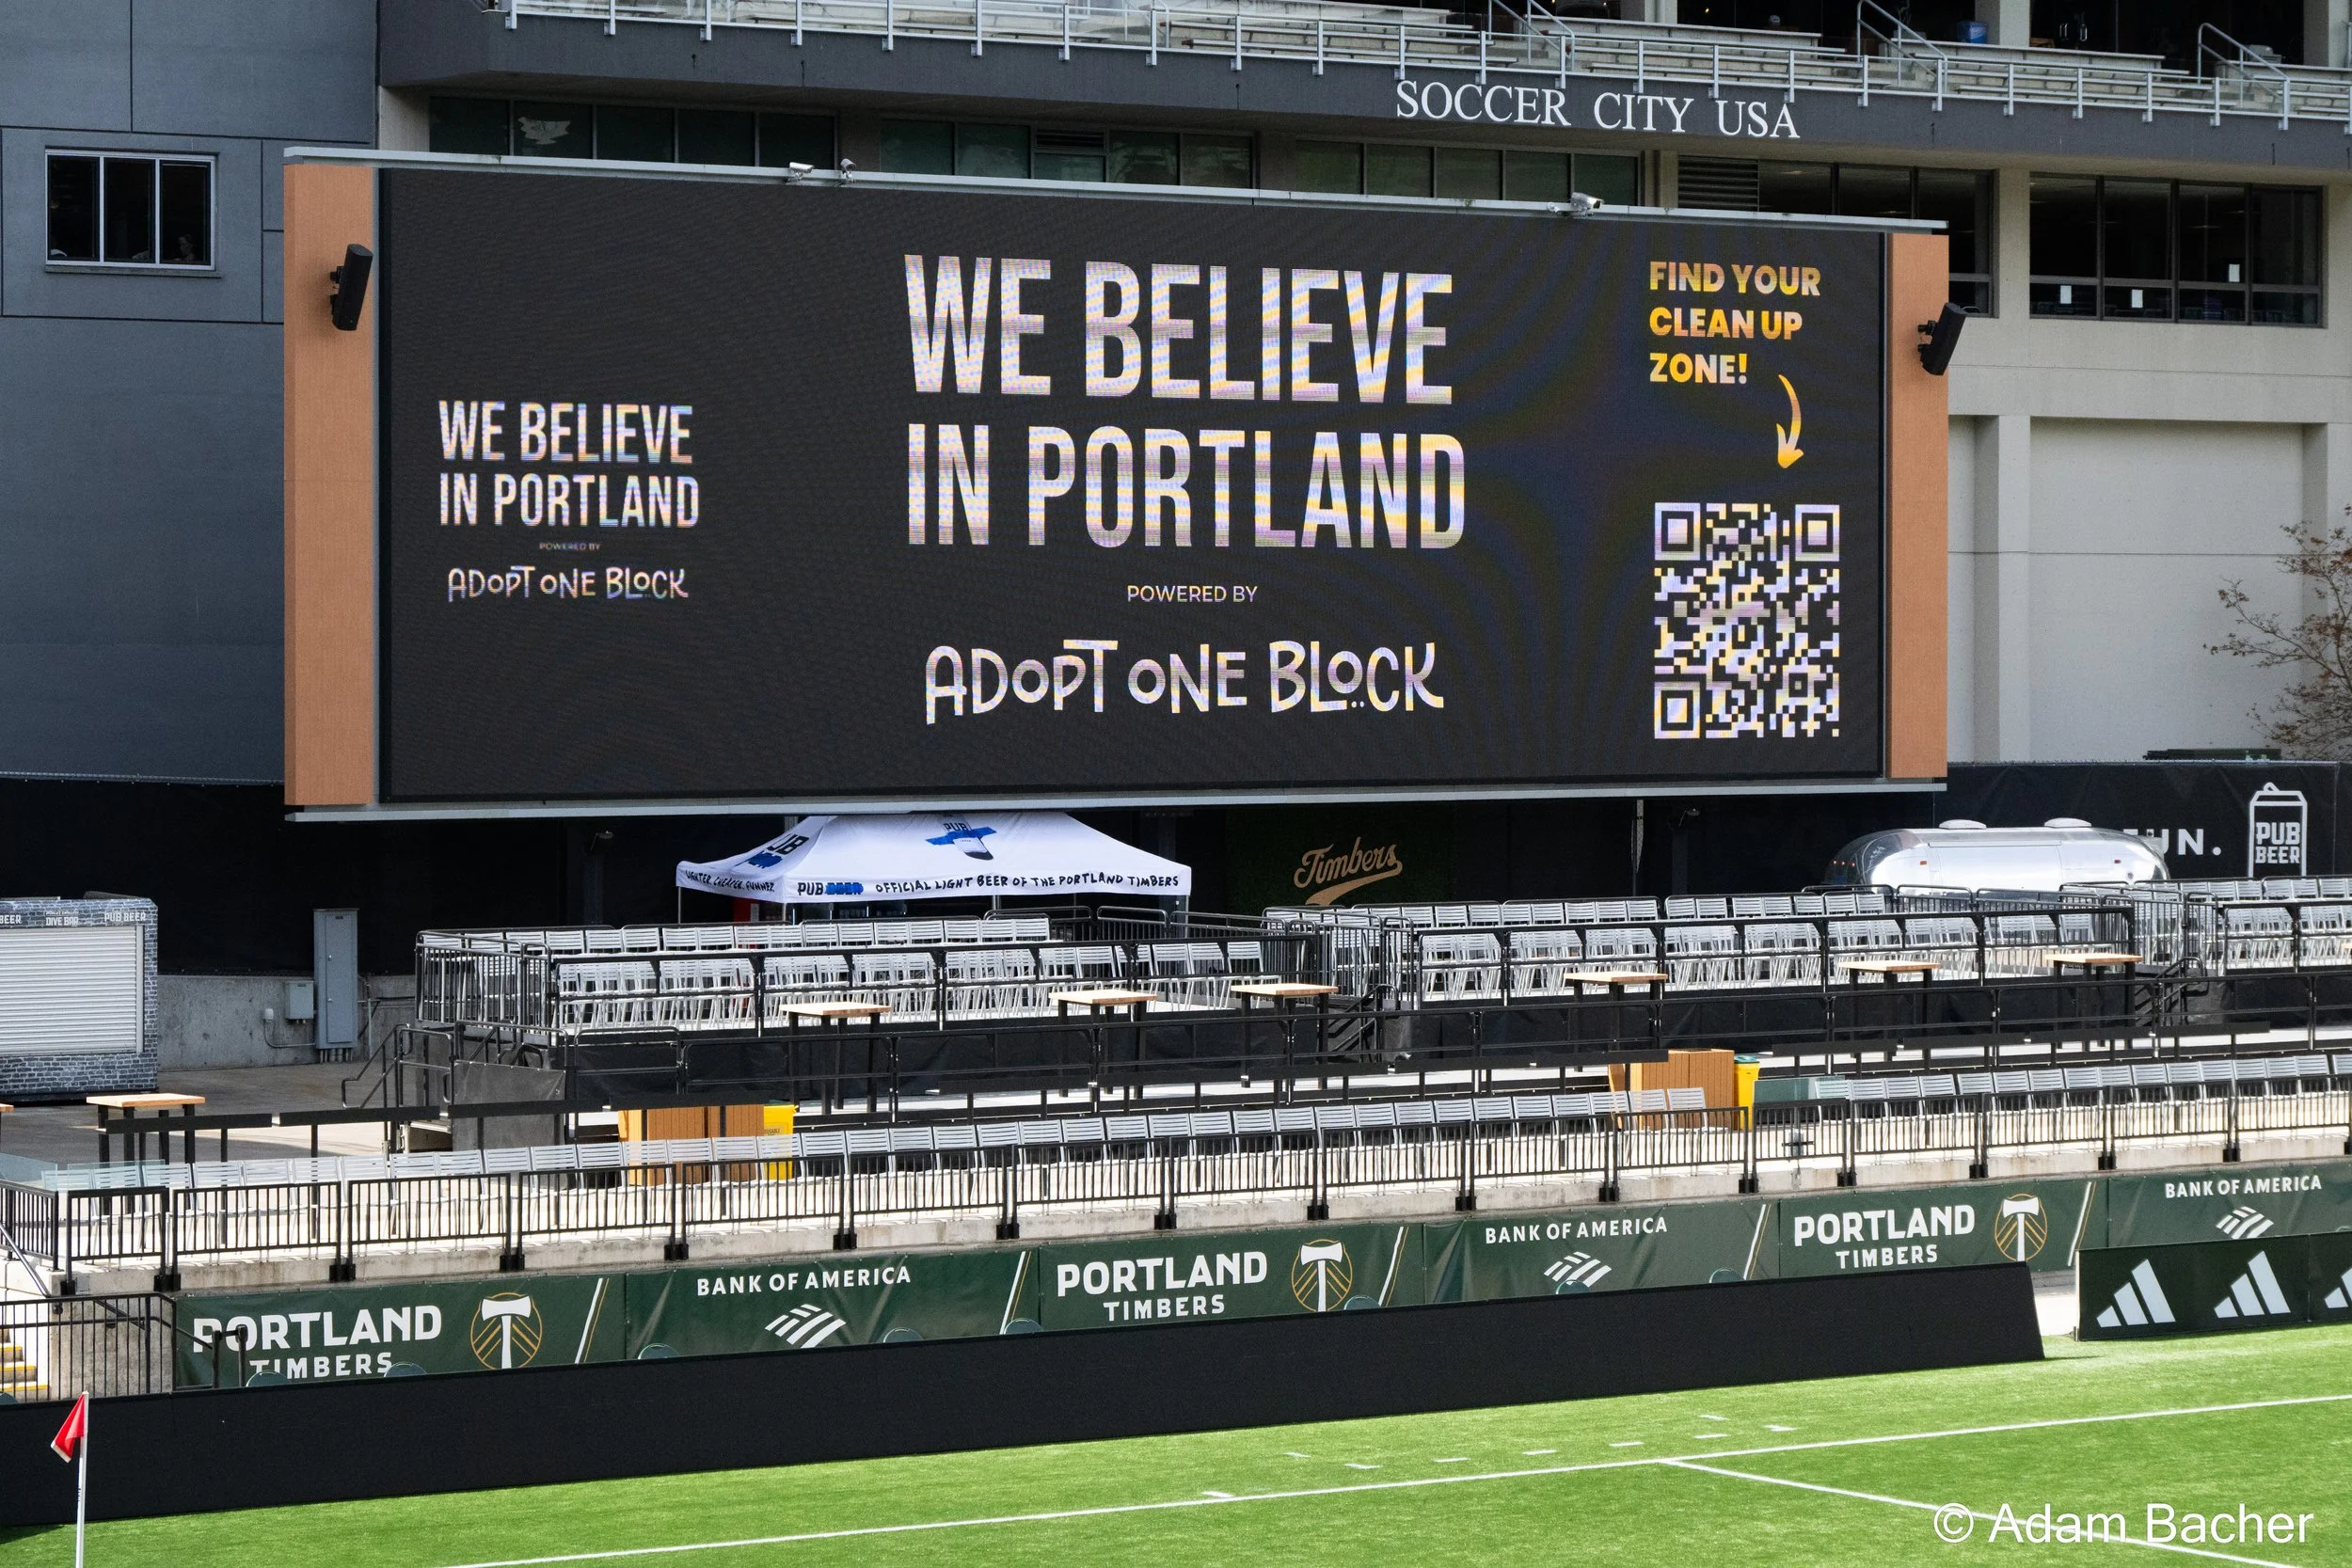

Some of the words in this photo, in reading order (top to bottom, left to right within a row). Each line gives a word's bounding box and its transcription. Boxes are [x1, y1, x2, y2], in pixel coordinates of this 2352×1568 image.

[1396, 80, 1571, 126] SOCCER
[1594, 92, 1694, 133] CITY
[1716, 100, 1801, 138] USA
[1649, 261, 1725, 293] FIND
[1731, 263, 1821, 296] YOUR
[904, 254, 1052, 396] WE
[1085, 261, 1453, 404] BELIEVE
[1649, 307, 1755, 340] CLEAN
[1761, 309, 1804, 341] UP
[1649, 352, 1748, 385] ZONE!
[438, 400, 505, 461] WE
[520, 402, 693, 464] BELIEVE
[909, 422, 990, 546] IN
[1028, 424, 1466, 549] PORTLAND
[439, 472, 478, 527] IN
[494, 472, 700, 529] PORTLAND
[538, 542, 587, 552] POWERED
[589, 542, 601, 551] BY
[1127, 584, 1227, 604] POWERED
[1233, 585, 1259, 603] BY
[2122, 828, 2222, 856] UN.
[2255, 821, 2301, 846] PUB
[1293, 835, 1400, 889] Timbers
[2255, 846, 2301, 864] BEER
[797, 881, 824, 896] PUB
[876, 879, 931, 894] OFFICIAL
[935, 877, 974, 890] LIGHT
[977, 874, 1009, 887] BEER
[1012, 877, 1027, 887] OF
[1030, 876, 1056, 887] THE
[1058, 871, 1124, 886] PORTLAND
[1127, 875, 1179, 887] TIMBERS
[0, 914, 22, 925] BEER
[45, 916, 64, 927] DIVE
[64, 916, 79, 927] BAR
[103, 911, 122, 923] PUB
[123, 911, 147, 922] BEER
[2165, 1180, 2215, 1199] BANK
[2217, 1179, 2240, 1196] OF
[2243, 1174, 2323, 1195] AMERICA
[1485, 1224, 1541, 1244] BANK
[1546, 1222, 1572, 1240] OF
[1576, 1216, 1668, 1239] AMERICA
[1794, 1204, 1976, 1247] PORTLAND
[1835, 1243, 1939, 1270] TIMBERS
[696, 1275, 763, 1296] BANK
[769, 1272, 800, 1292] OF
[804, 1266, 912, 1290] AMERICA
[1057, 1251, 1268, 1297] PORTLAND
[1103, 1293, 1225, 1322] TIMBERS
[192, 1305, 443, 1354] PORTLAND
[249, 1351, 393, 1380] TIMBERS
